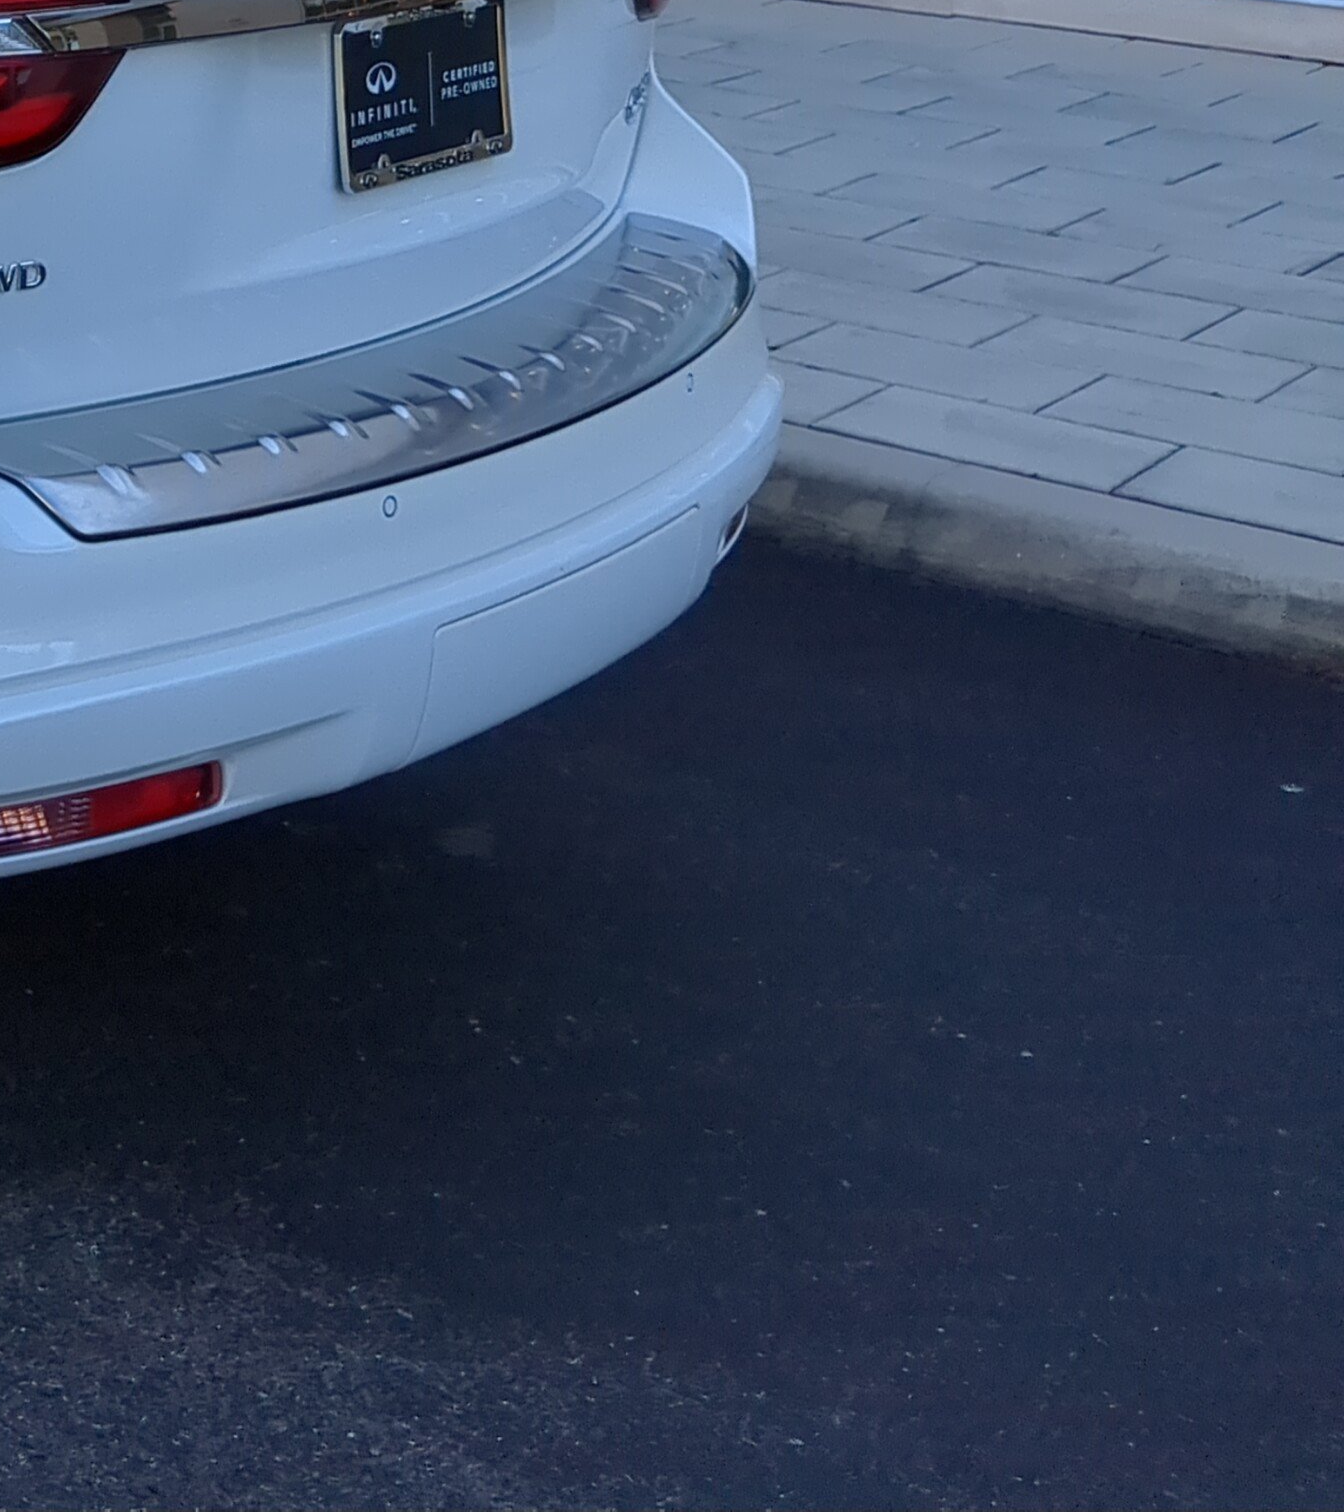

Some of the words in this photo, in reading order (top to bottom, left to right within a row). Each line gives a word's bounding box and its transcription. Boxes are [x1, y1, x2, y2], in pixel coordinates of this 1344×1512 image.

[442, 60, 496, 83] CERTIFIED
[440, 76, 498, 100] PRE-OWNED
[395, 150, 474, 180] Sarasota
